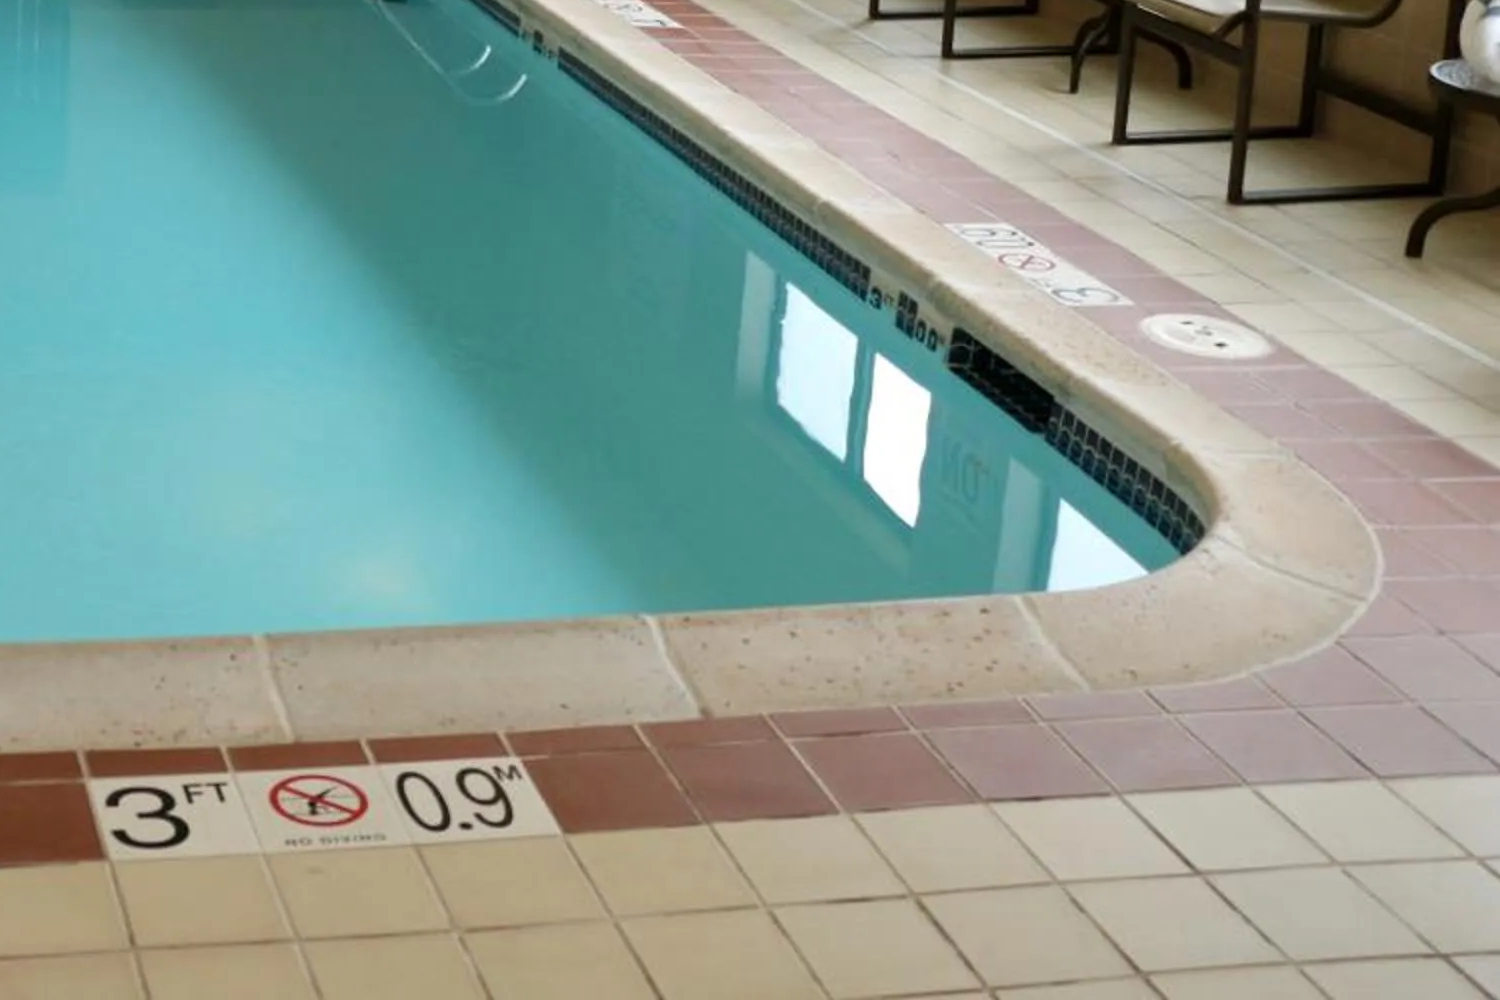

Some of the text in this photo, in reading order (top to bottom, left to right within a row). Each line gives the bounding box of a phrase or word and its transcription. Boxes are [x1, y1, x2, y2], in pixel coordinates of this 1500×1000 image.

[104, 763, 523, 850] 3 FT 0.9 M
